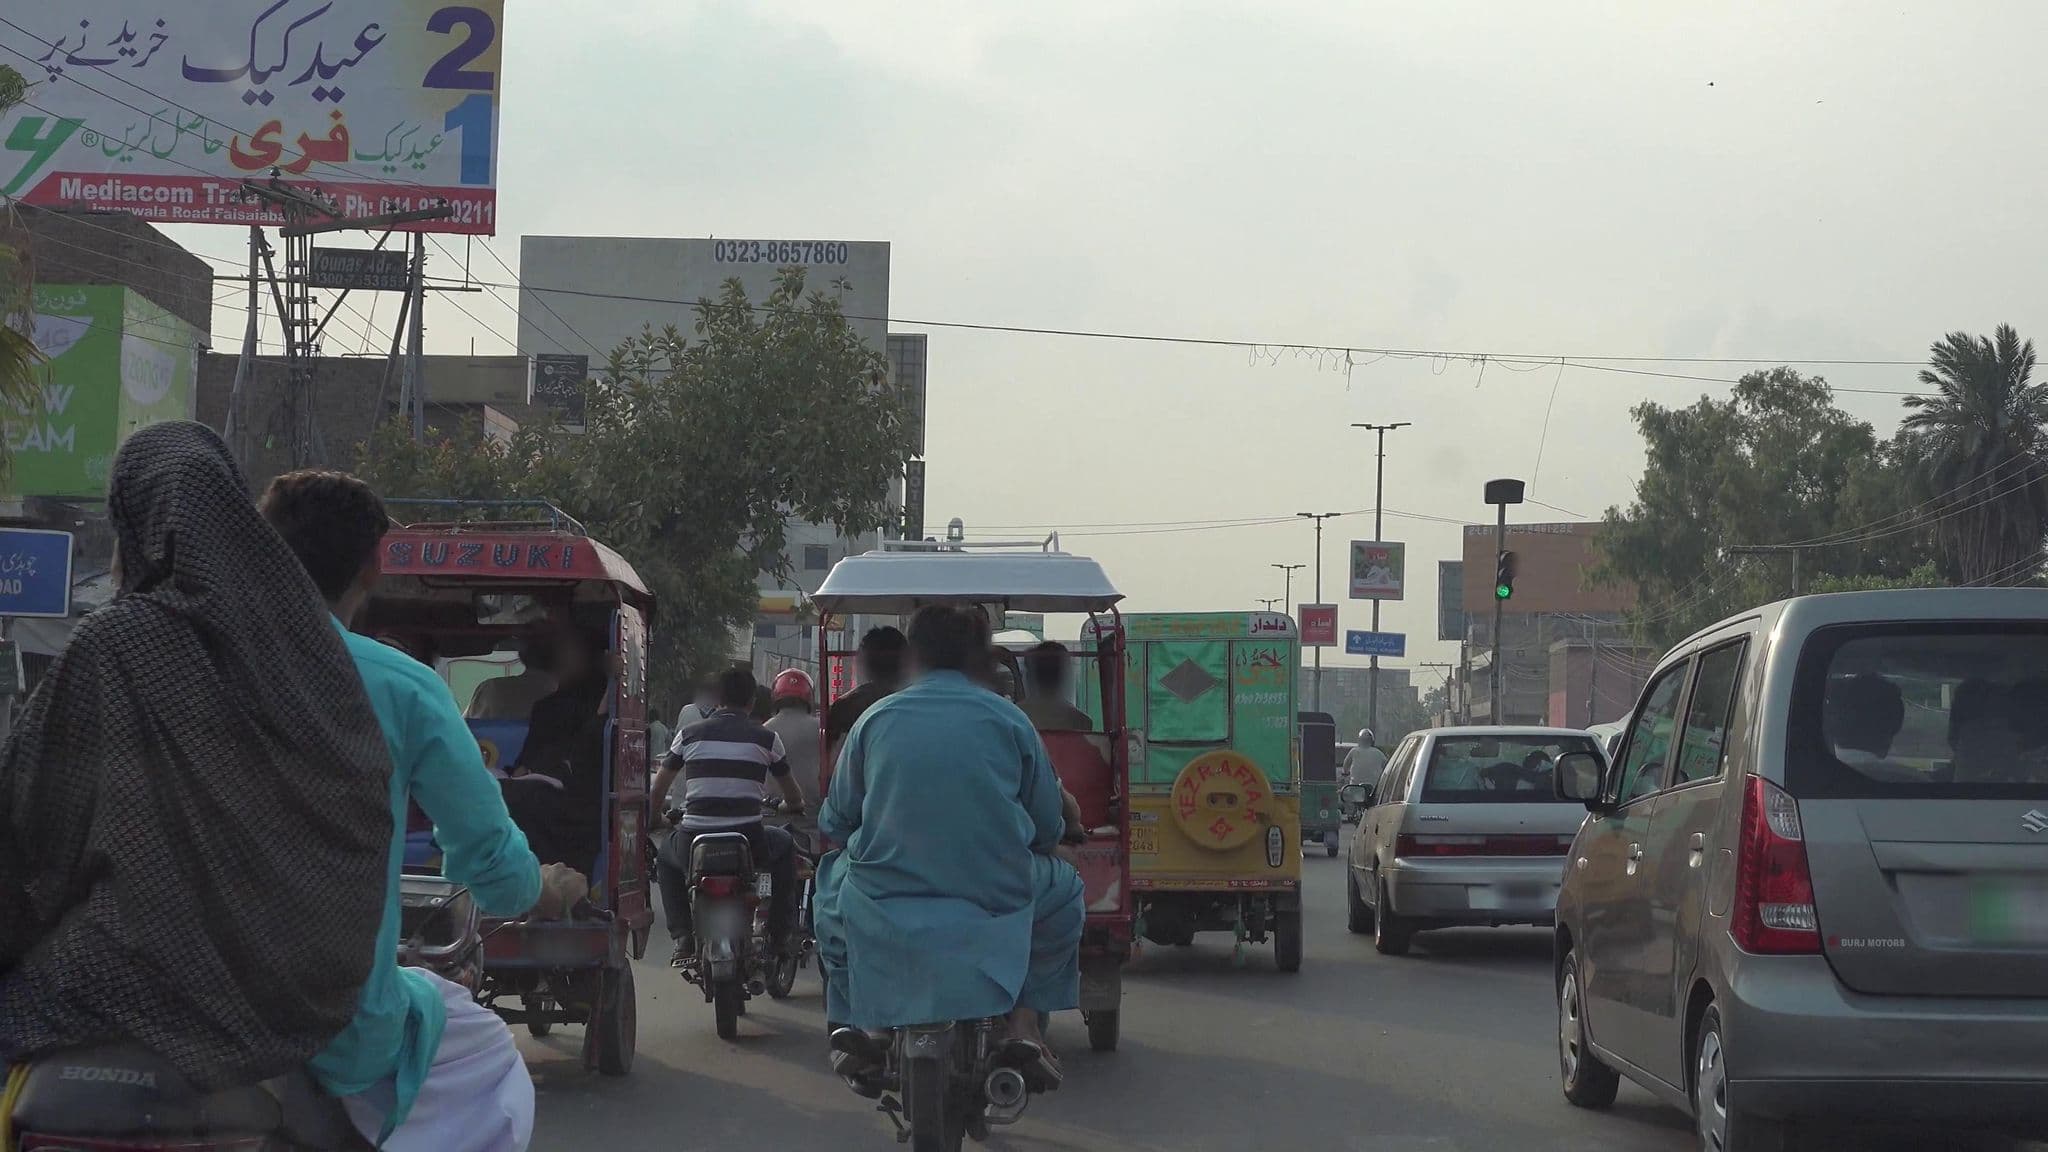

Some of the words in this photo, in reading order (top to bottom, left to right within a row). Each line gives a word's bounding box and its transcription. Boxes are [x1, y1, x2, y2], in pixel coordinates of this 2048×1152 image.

[422, 6, 495, 90] 2
[60, 178, 193, 204] Mediacom
[172, 206, 210, 219] Road
[714, 240, 848, 265] 0323-8657860
[388, 542, 575, 569] SUZUKI
[1250, 616, 1287, 633] دلدار
[58, 1066, 159, 1089] HONDA
